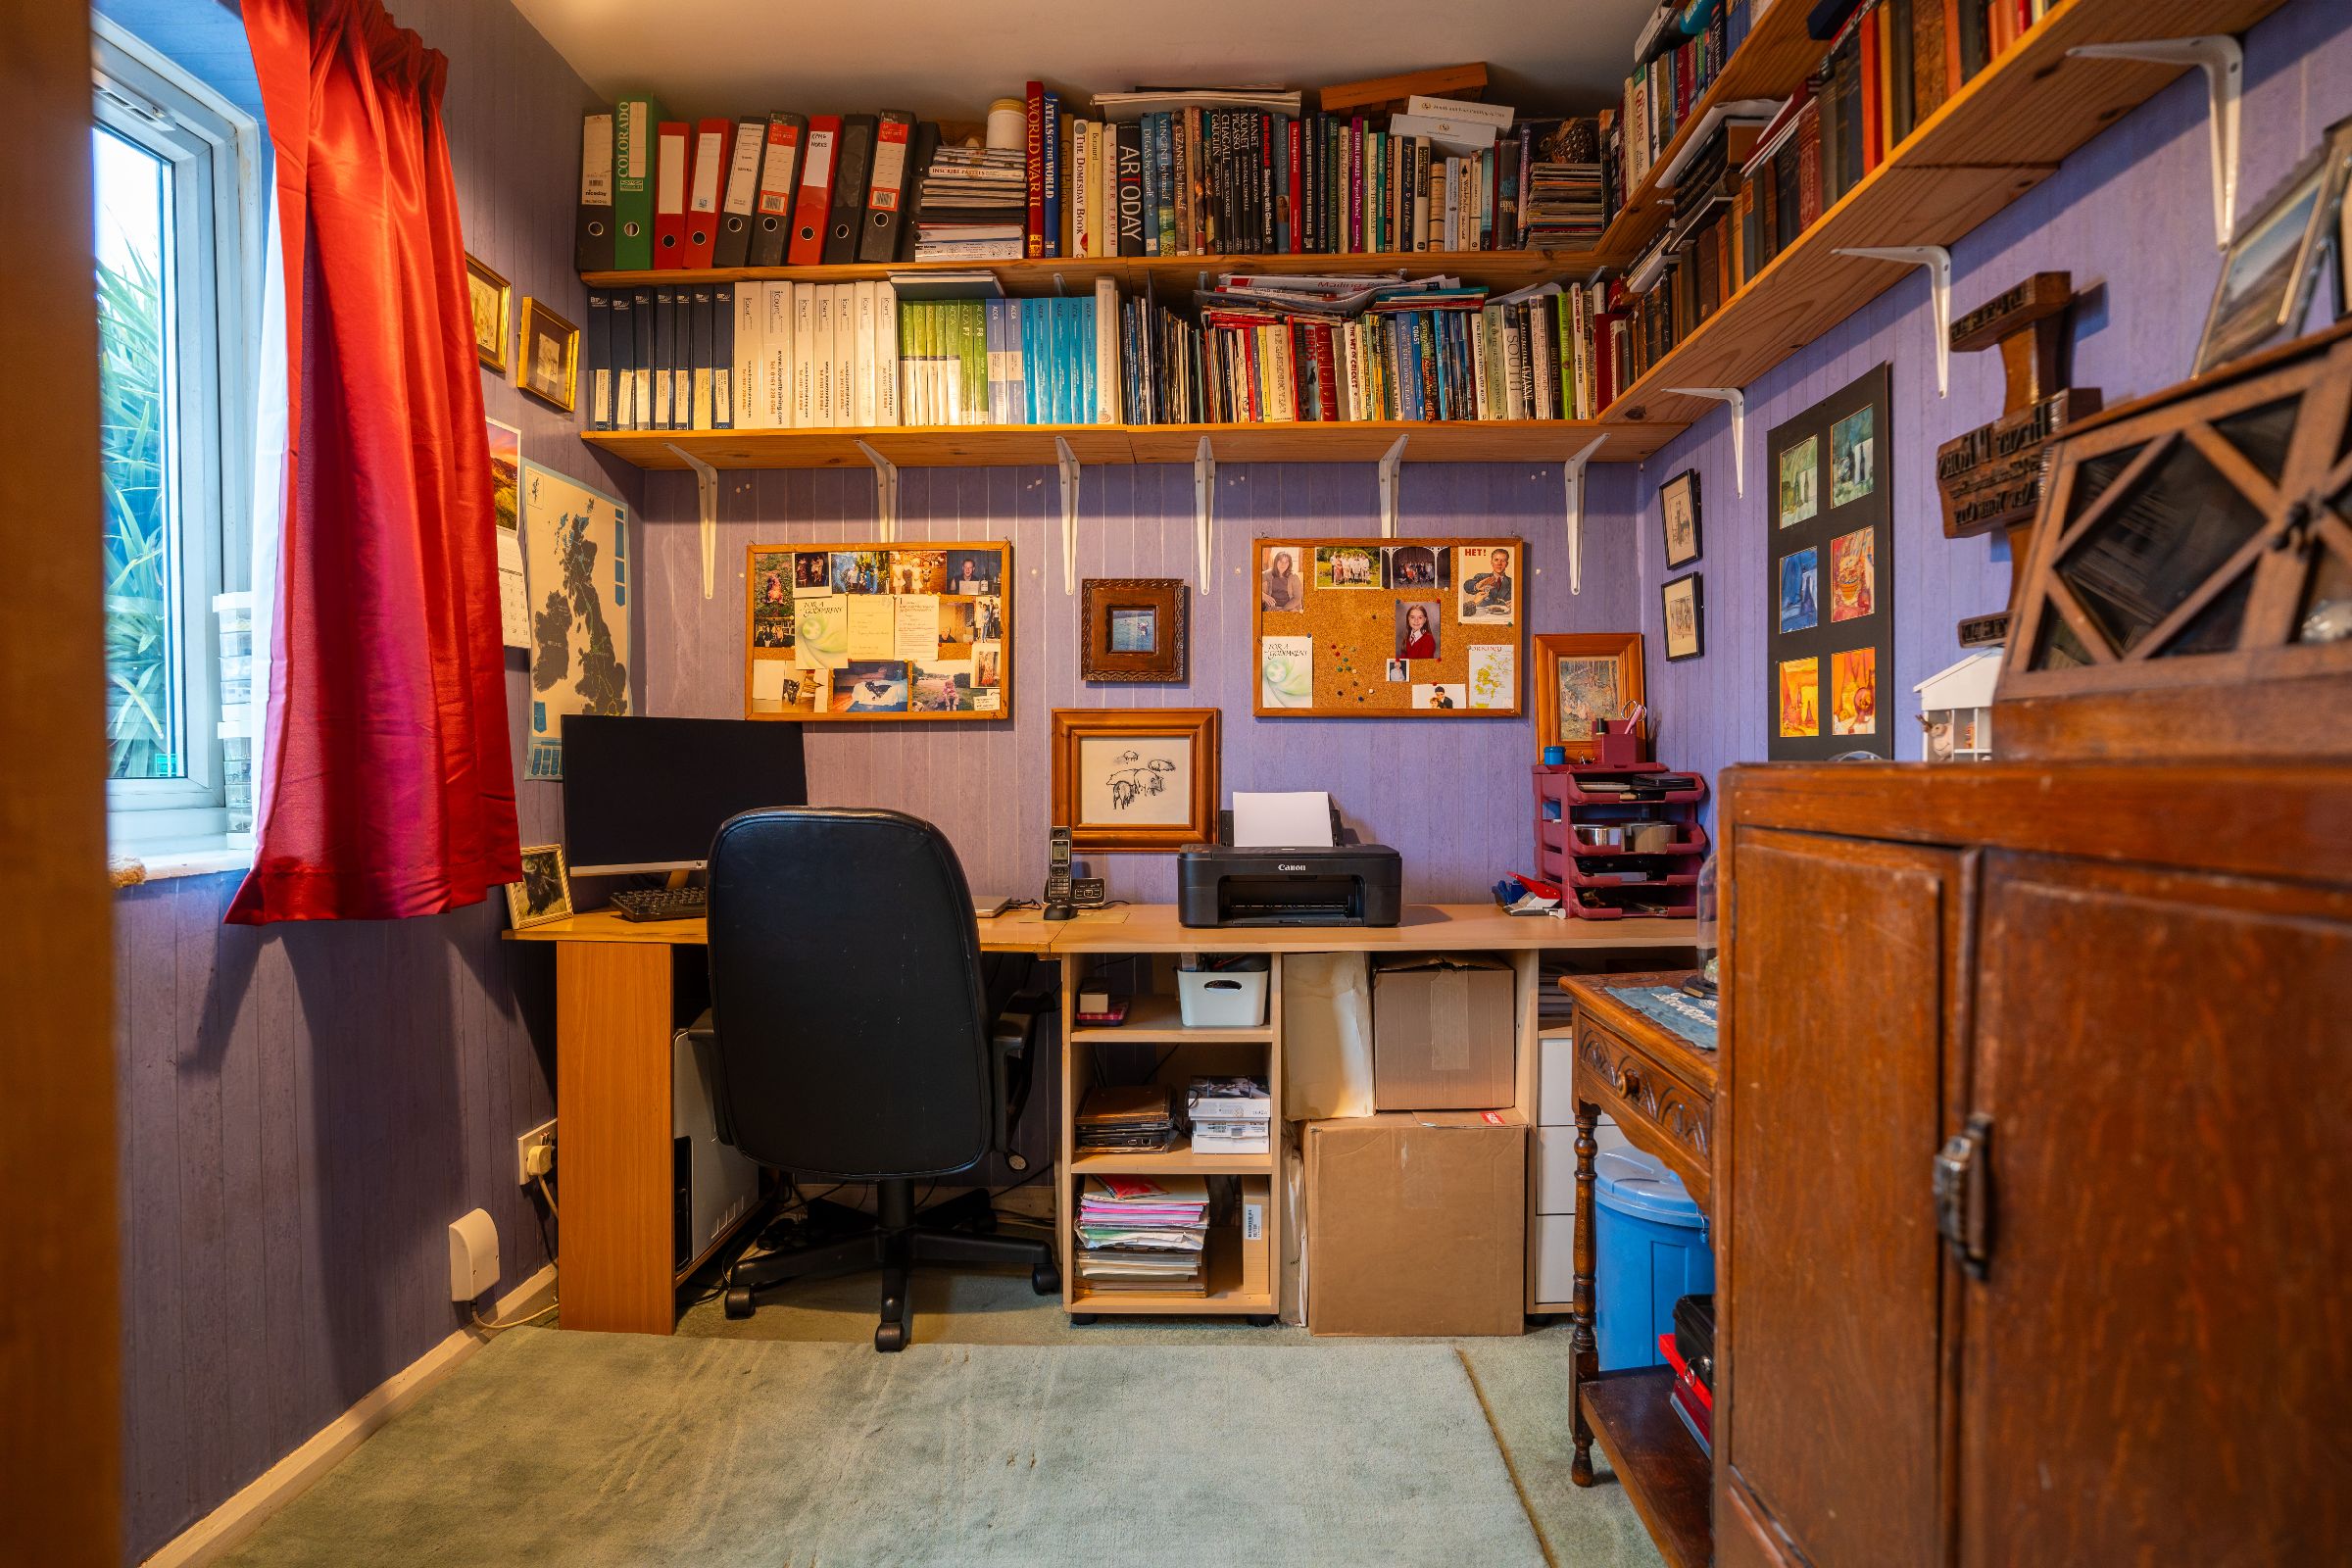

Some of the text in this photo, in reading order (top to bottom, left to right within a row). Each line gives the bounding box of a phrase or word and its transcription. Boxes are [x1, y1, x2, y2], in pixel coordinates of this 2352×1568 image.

[1046, 102, 1055, 135] ATLAS
[1232, 113, 1241, 150] PICASSO
[1241, 113, 1250, 149] MONET
[1636, 89, 1645, 143] QUEEN
[618, 101, 629, 178] COLORADO
[1029, 96, 1040, 207] WORLD WAR II
[1047, 135, 1054, 145] OF
[1144, 128, 1152, 158] DEGAS
[1159, 119, 1168, 160] VINCENT
[1212, 114, 1221, 157] GAUGUIN
[1221, 114, 1230, 164] CHAGALL
[1046, 161, 1055, 199] WORLD
[1076, 134, 1085, 235] THE DOMESDAY BOOK
[773, 290, 783, 315] iCount
[962, 326, 970, 336] F7
[976, 327, 984, 337] F8
[1304, 328, 1316, 362] BIRDS
[1507, 335, 1521, 392] SOUTH
